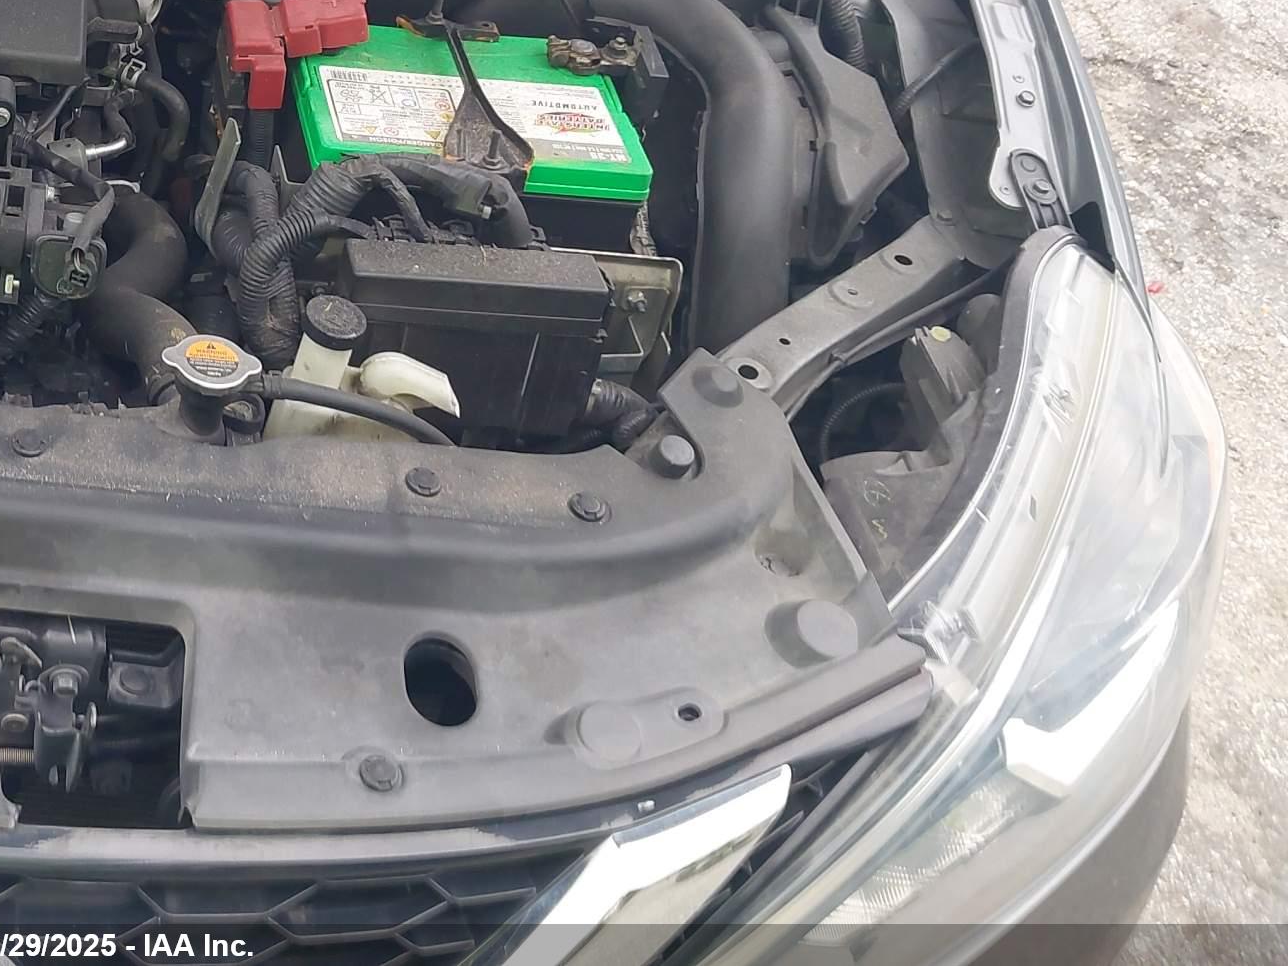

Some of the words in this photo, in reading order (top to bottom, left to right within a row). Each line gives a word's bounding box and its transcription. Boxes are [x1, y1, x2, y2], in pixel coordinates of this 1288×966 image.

[531, 100, 598, 111] AUTOMOTIVE
[537, 113, 605, 124] BATTERIES
[535, 120, 610, 131] INTERSTATE
